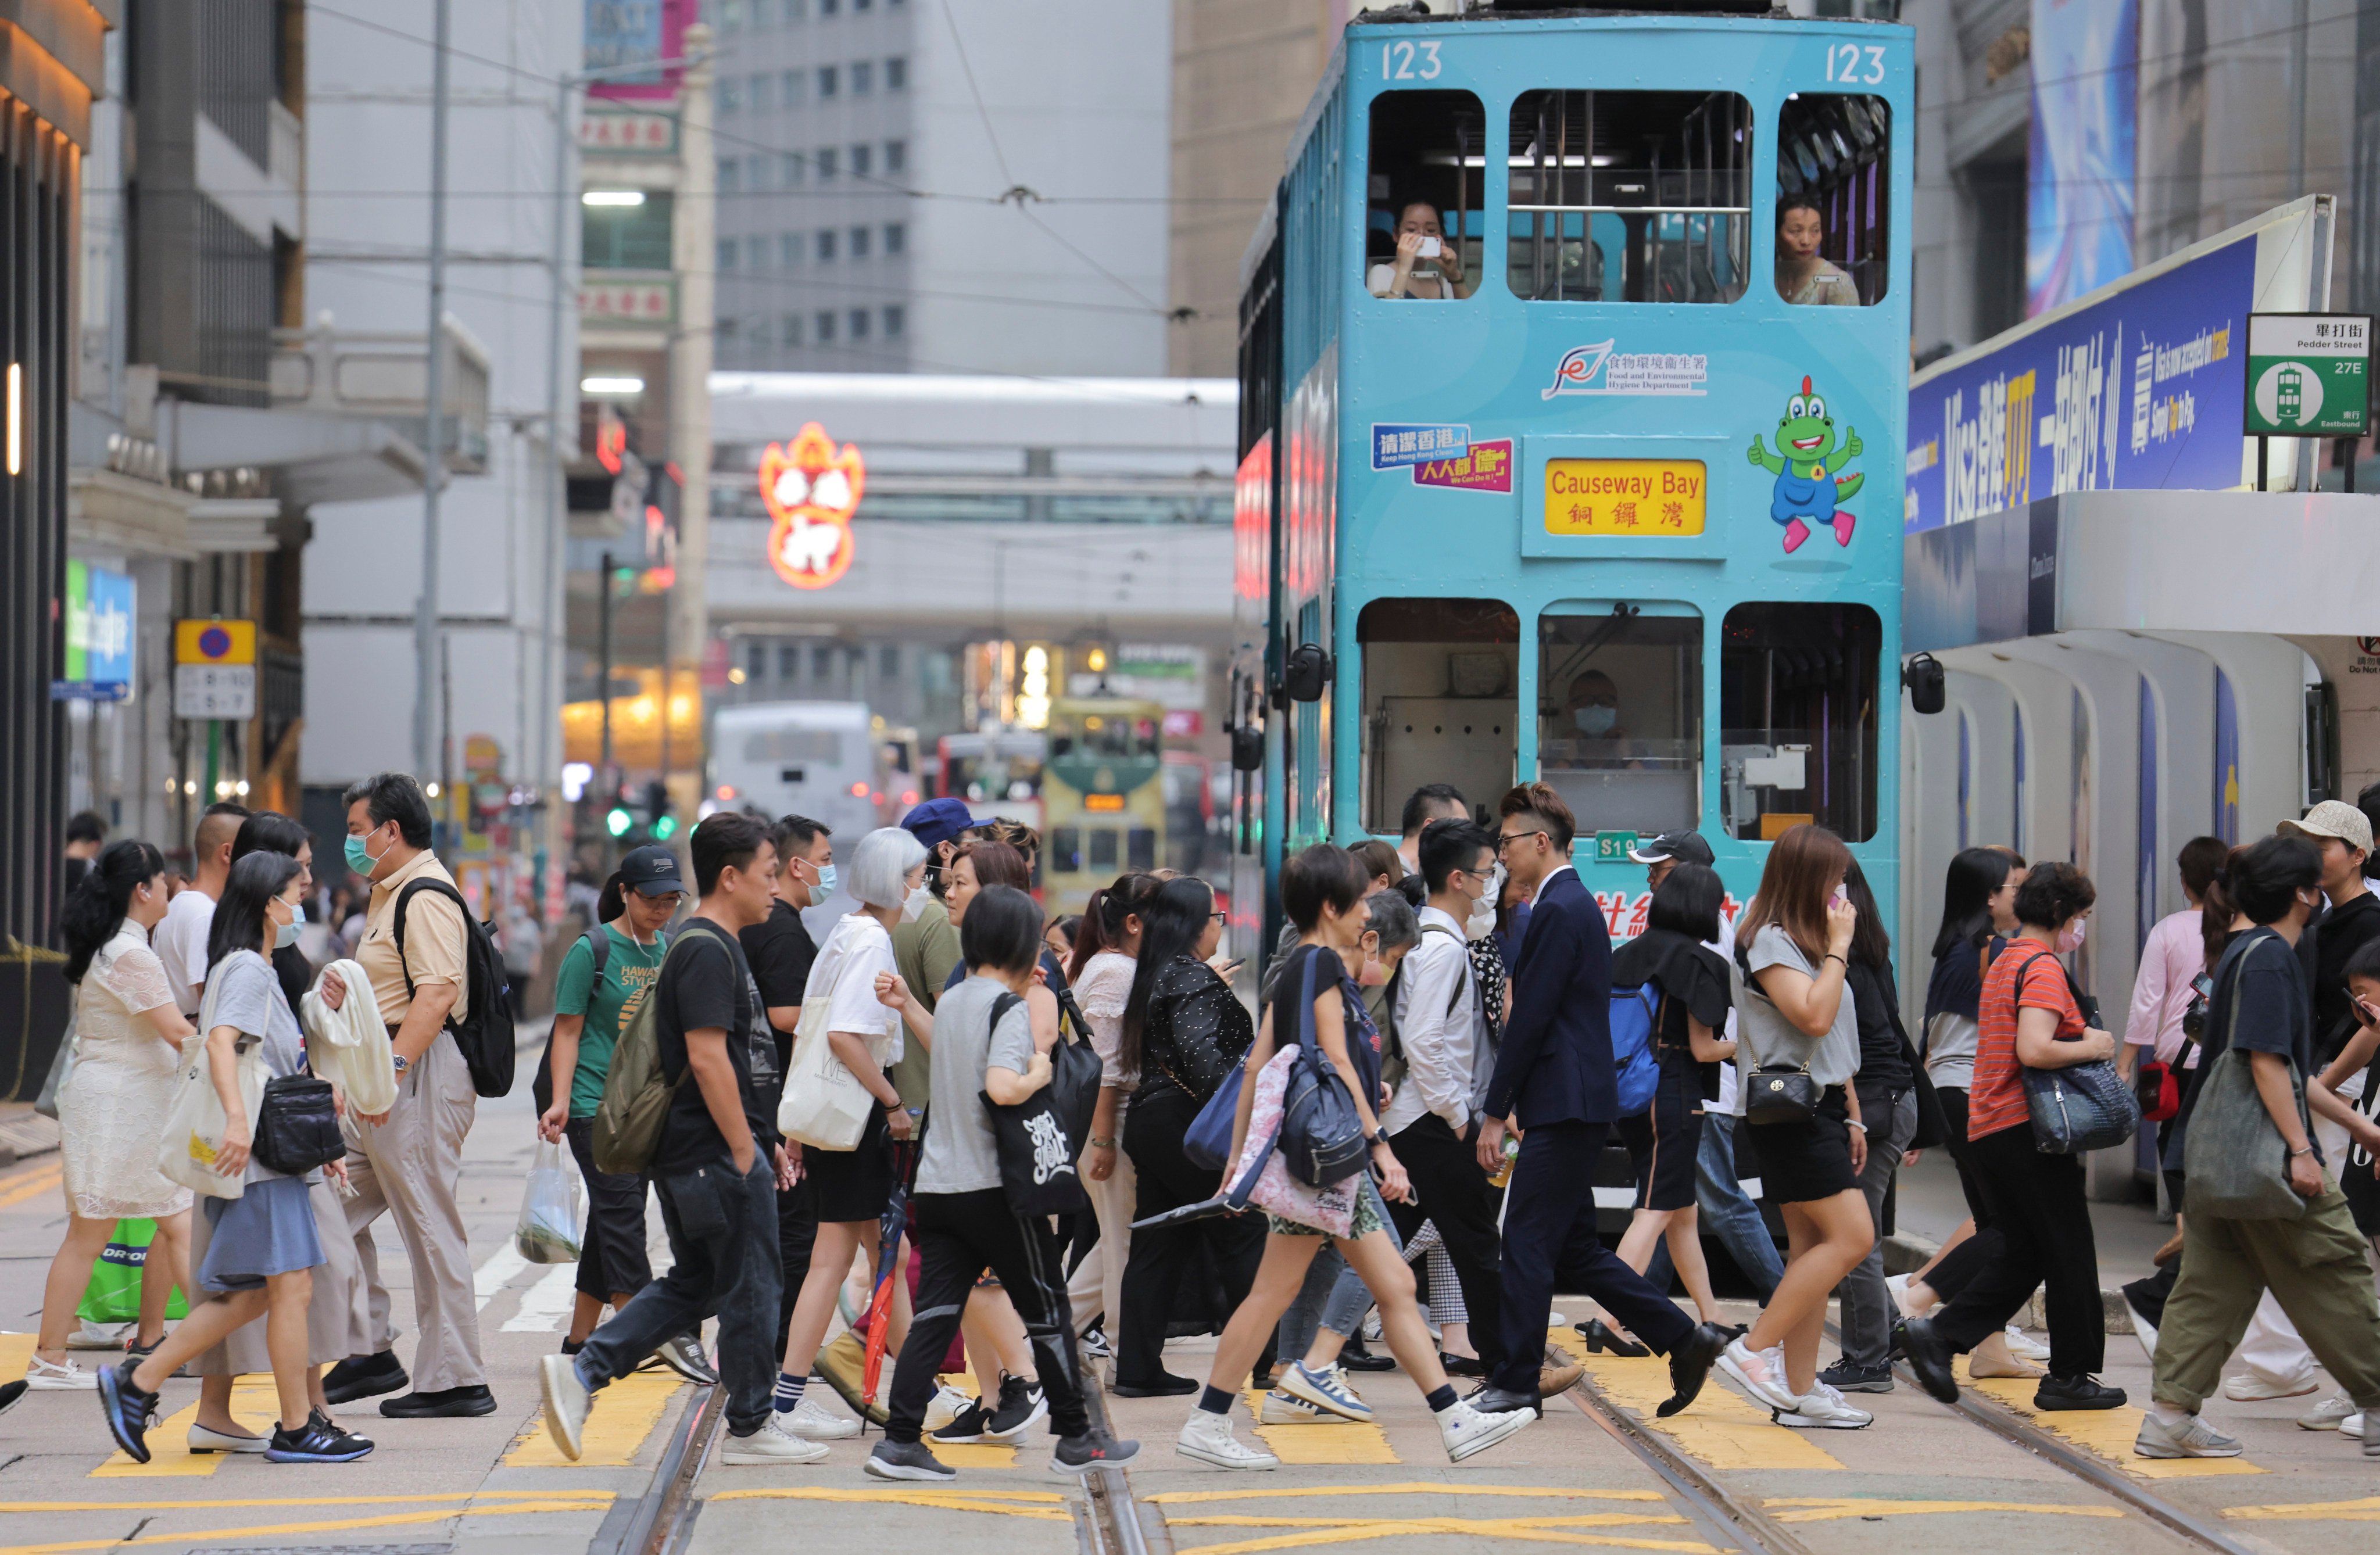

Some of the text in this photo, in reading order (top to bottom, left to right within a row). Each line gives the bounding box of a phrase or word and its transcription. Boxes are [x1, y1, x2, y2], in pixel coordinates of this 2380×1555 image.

[1383, 41, 1441, 80] 123
[1827, 43, 1886, 84] 123
[2316, 323, 2363, 338] 畢打街
[1648, 372, 1705, 380] Environmental
[2335, 362, 2362, 374] 27E
[1609, 381, 1689, 390] Hygiene Department
[2343, 411, 2360, 420] 東行
[1381, 428, 1454, 454] 清潔香港
[1381, 449, 1454, 463] Keep Hong Kong Clean
[1552, 470, 1699, 499] Causeway Bay
[1567, 501, 1684, 528] 銅鑼灣
[1601, 839, 1635, 856] S19
[621, 976, 654, 987] STYLE
[822, 1054, 848, 1083] WE
